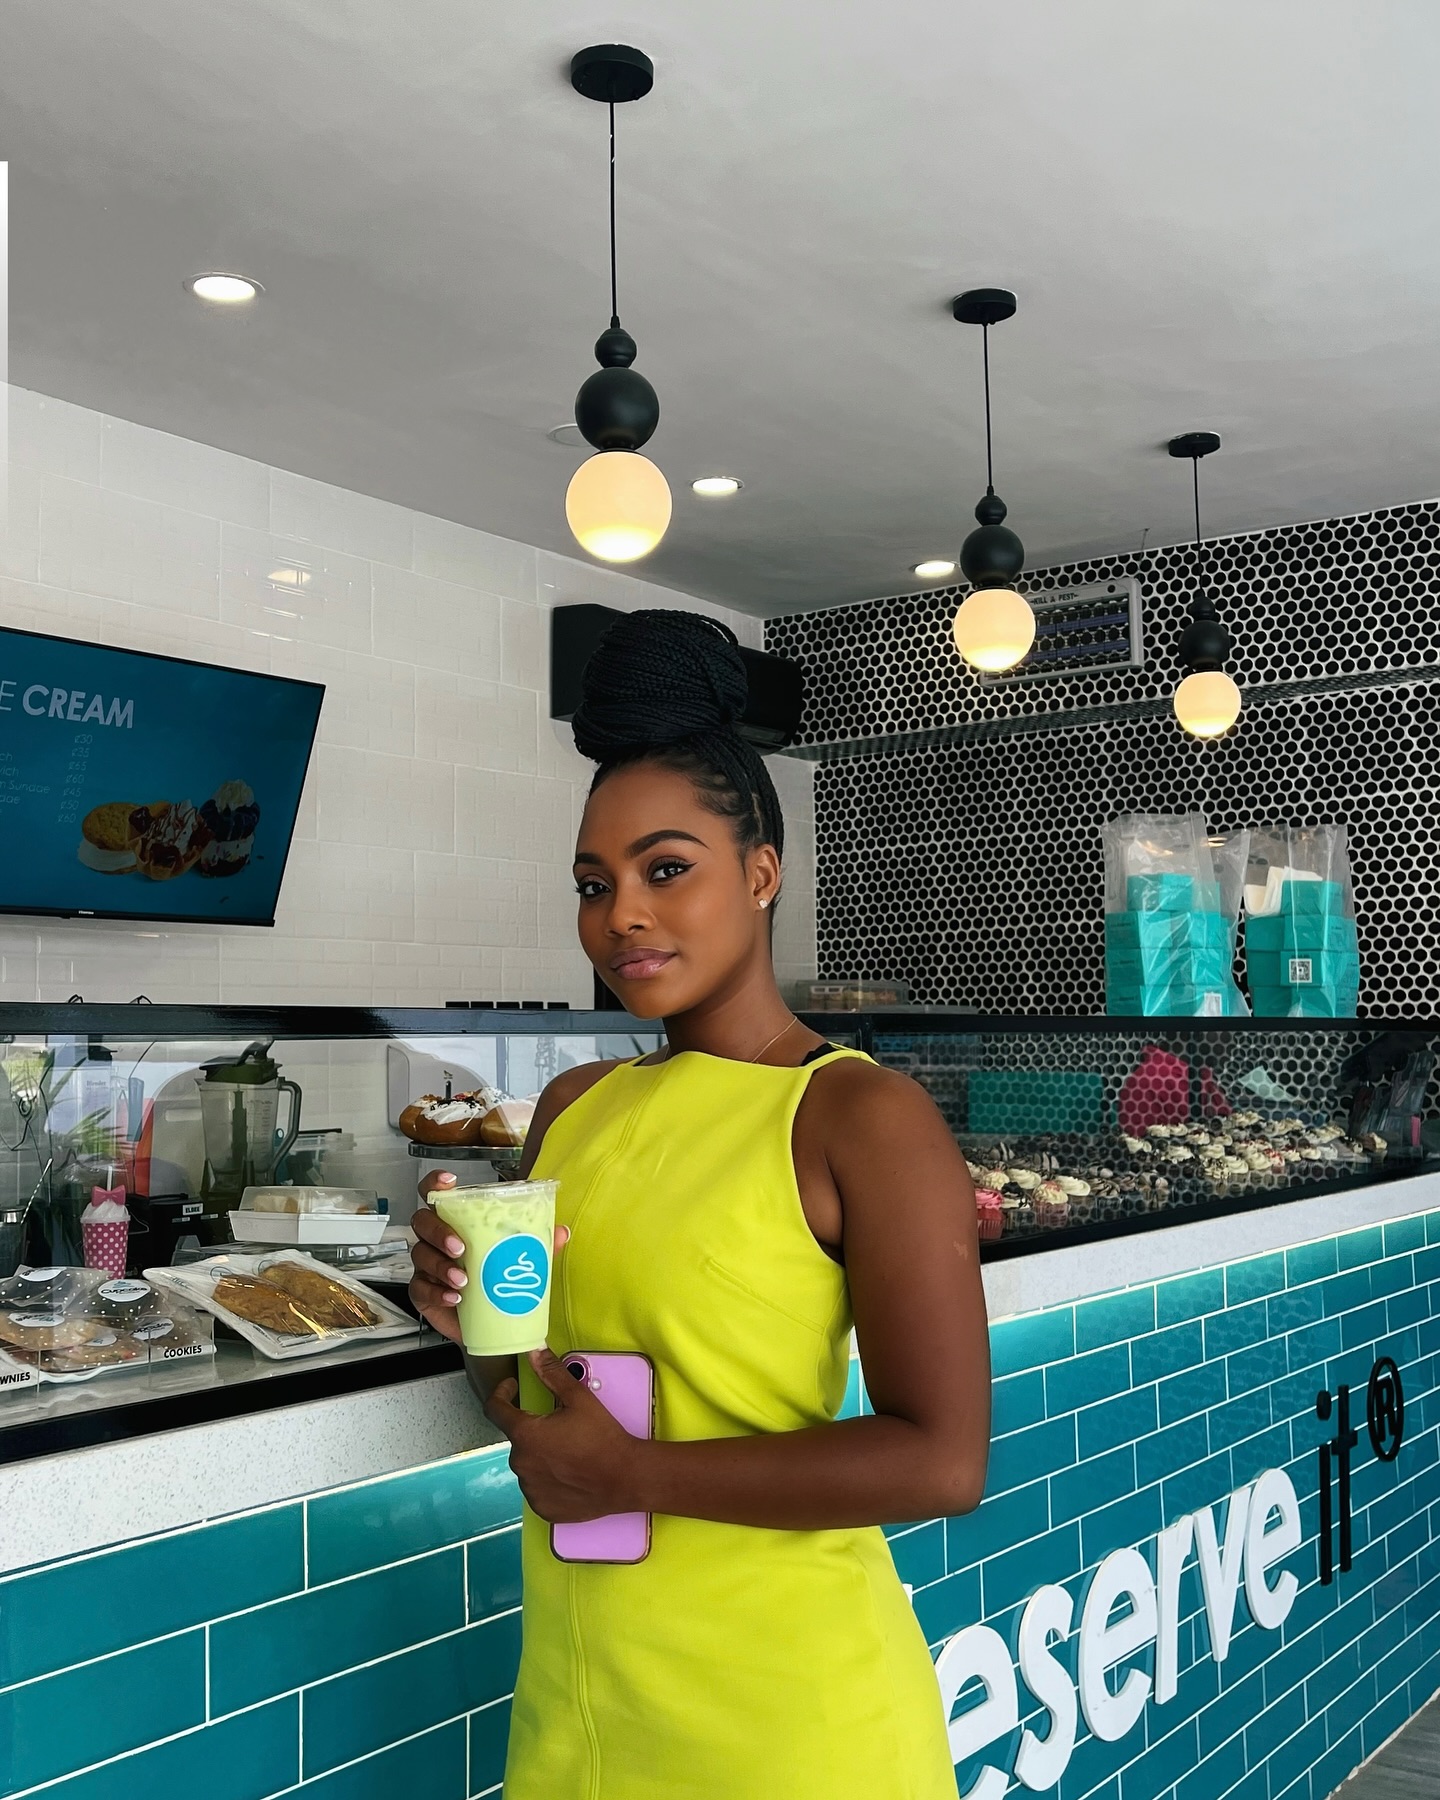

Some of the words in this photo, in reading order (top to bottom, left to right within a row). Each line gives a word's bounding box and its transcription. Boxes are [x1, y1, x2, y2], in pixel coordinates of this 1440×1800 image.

[22, 684, 134, 729] CREAM
[164, 1345, 202, 1358] COOKIES
[902, 1469, 1302, 1800] eserve
